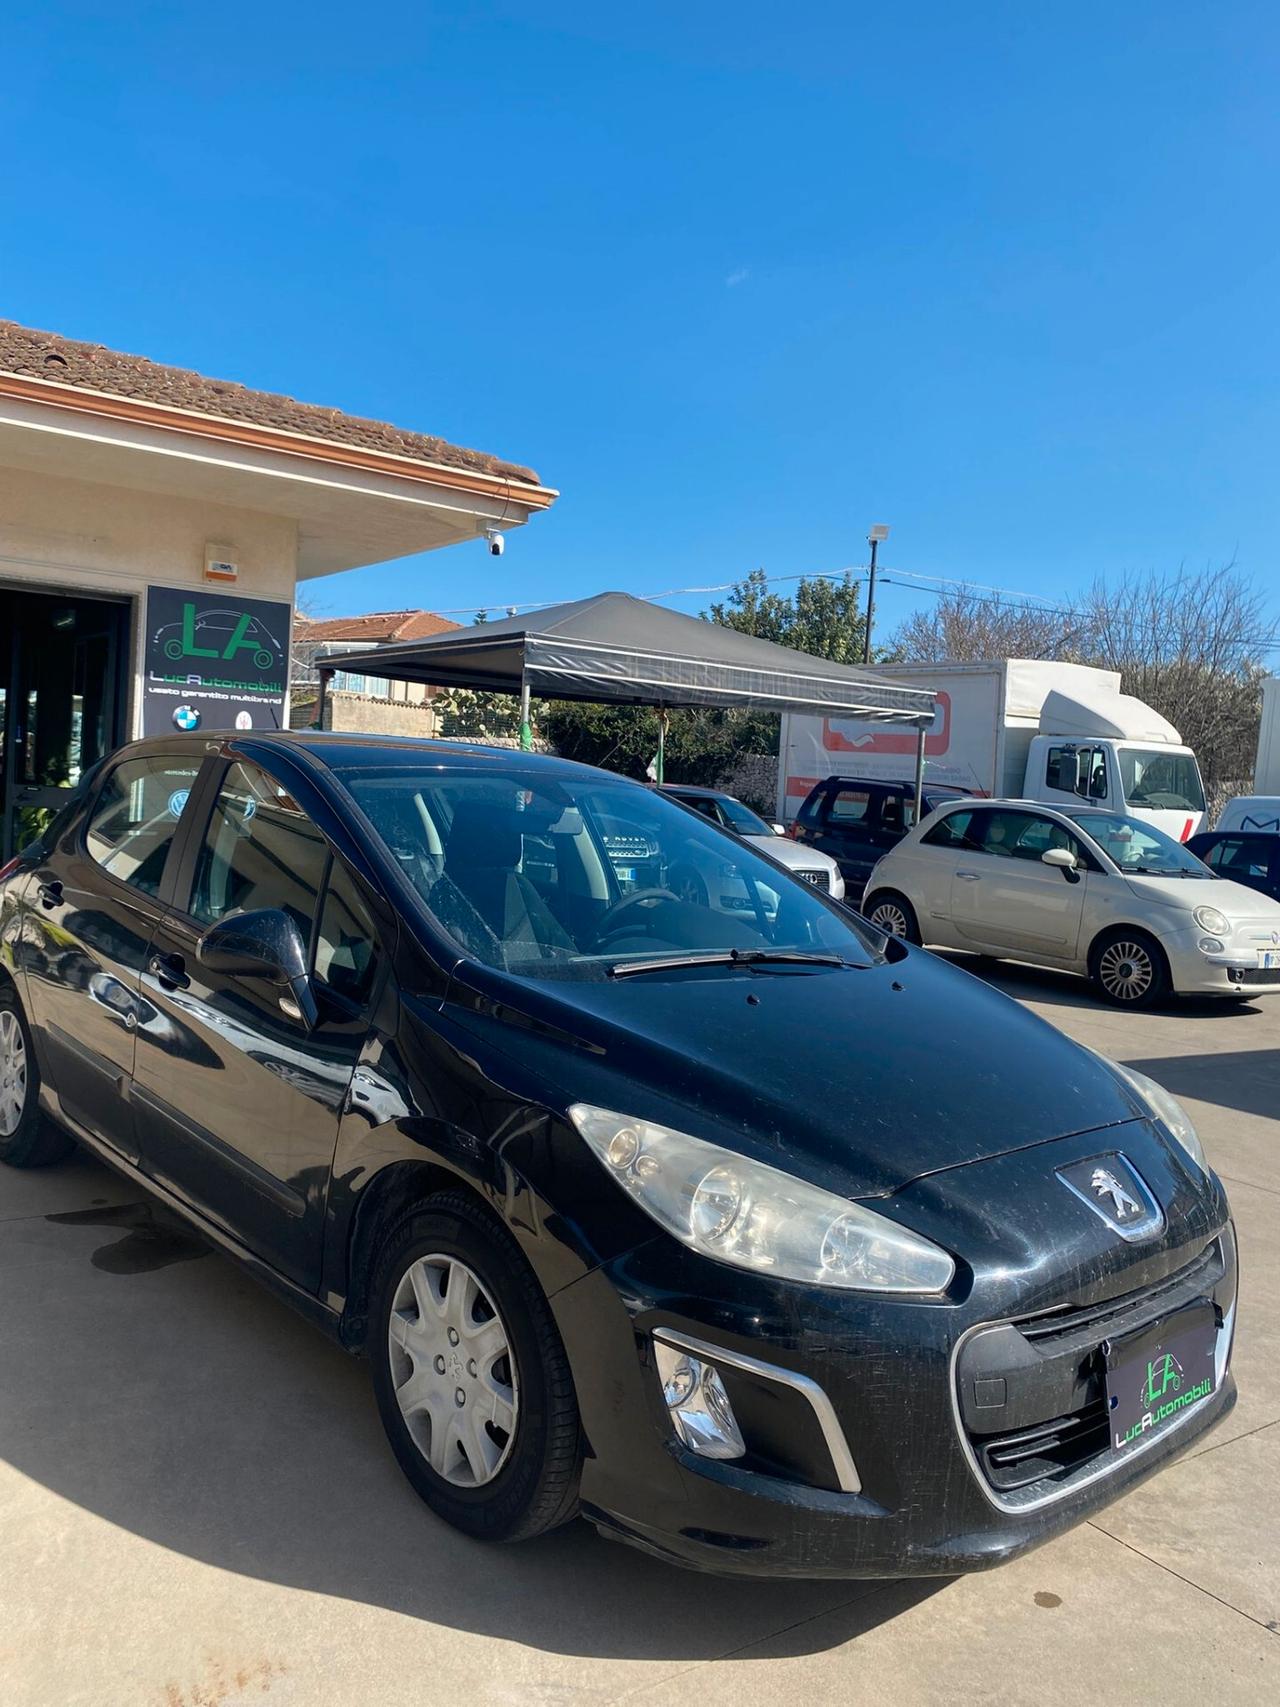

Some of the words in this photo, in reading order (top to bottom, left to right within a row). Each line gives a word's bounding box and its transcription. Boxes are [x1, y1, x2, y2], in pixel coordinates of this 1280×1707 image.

[149, 671, 282, 693] LucAutomobili
[148, 687, 180, 696] usato
[181, 689, 229, 699] garantito
[230, 694, 283, 705] multibrand
[1115, 1378, 1212, 1449] LucAutomobili
